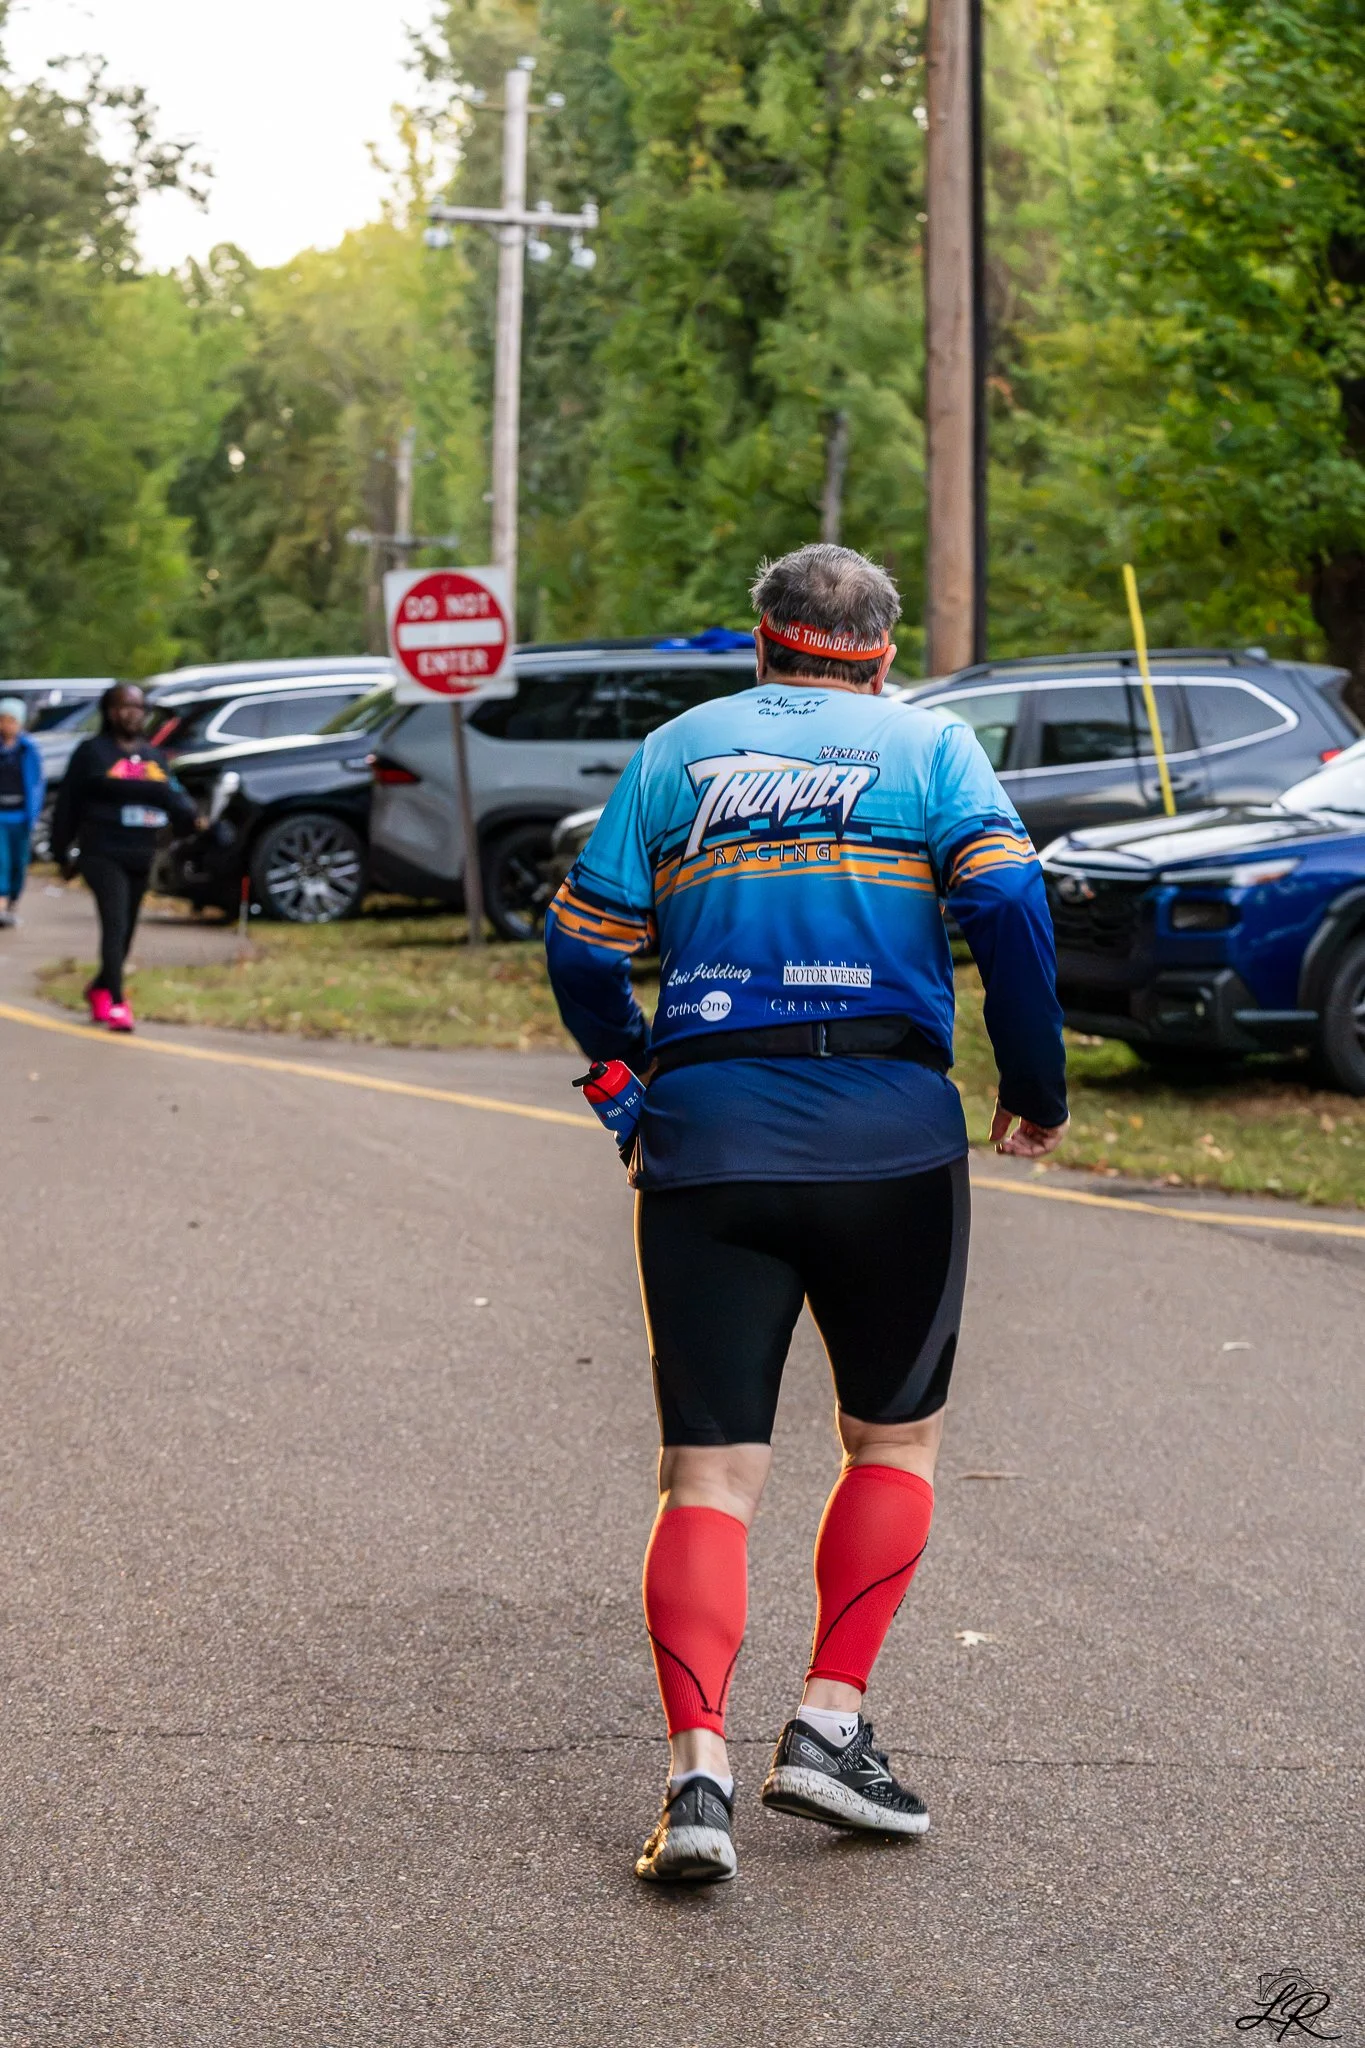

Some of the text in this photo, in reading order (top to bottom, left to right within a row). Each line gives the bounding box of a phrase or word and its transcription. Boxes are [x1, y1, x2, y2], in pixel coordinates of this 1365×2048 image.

[404, 591, 490, 620] DO NOT
[803, 628, 856, 652] THUNDER
[416, 648, 490, 676] ENTER
[815, 745, 880, 763] MEMPHIS
[685, 749, 877, 862] THUNDER
[713, 843, 832, 866] RACING
[785, 968, 871, 986] MOTOR WERKS
[770, 998, 848, 1013] CREWS
[624, 1091, 640, 1108] 13.1
